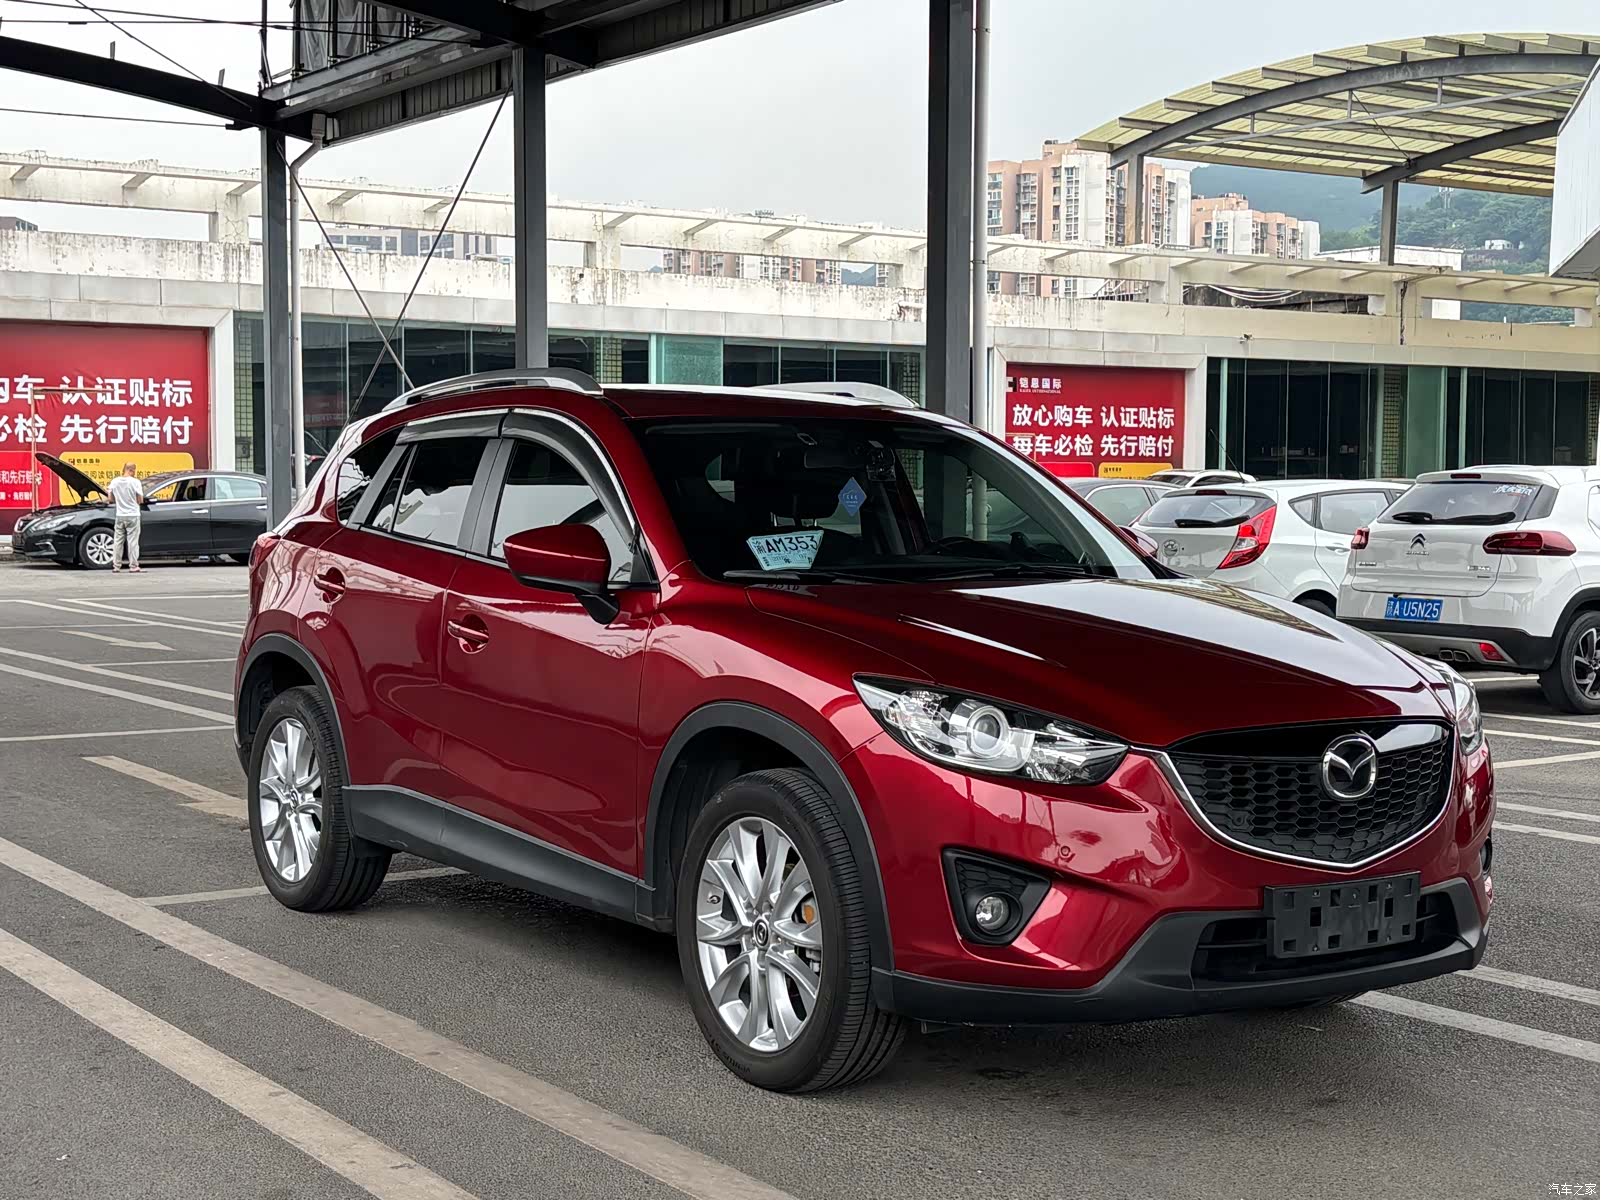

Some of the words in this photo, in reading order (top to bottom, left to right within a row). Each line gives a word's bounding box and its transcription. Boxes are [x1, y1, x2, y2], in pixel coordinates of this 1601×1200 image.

[60, 376, 193, 408] 认证贴标
[60, 415, 193, 445] 先行赔付
[1012, 404, 1093, 427] 放心购车
[1100, 405, 1175, 429] 认证贴标
[1012, 434, 1094, 457] 每车必检
[1100, 434, 1175, 457] 先行赔付
